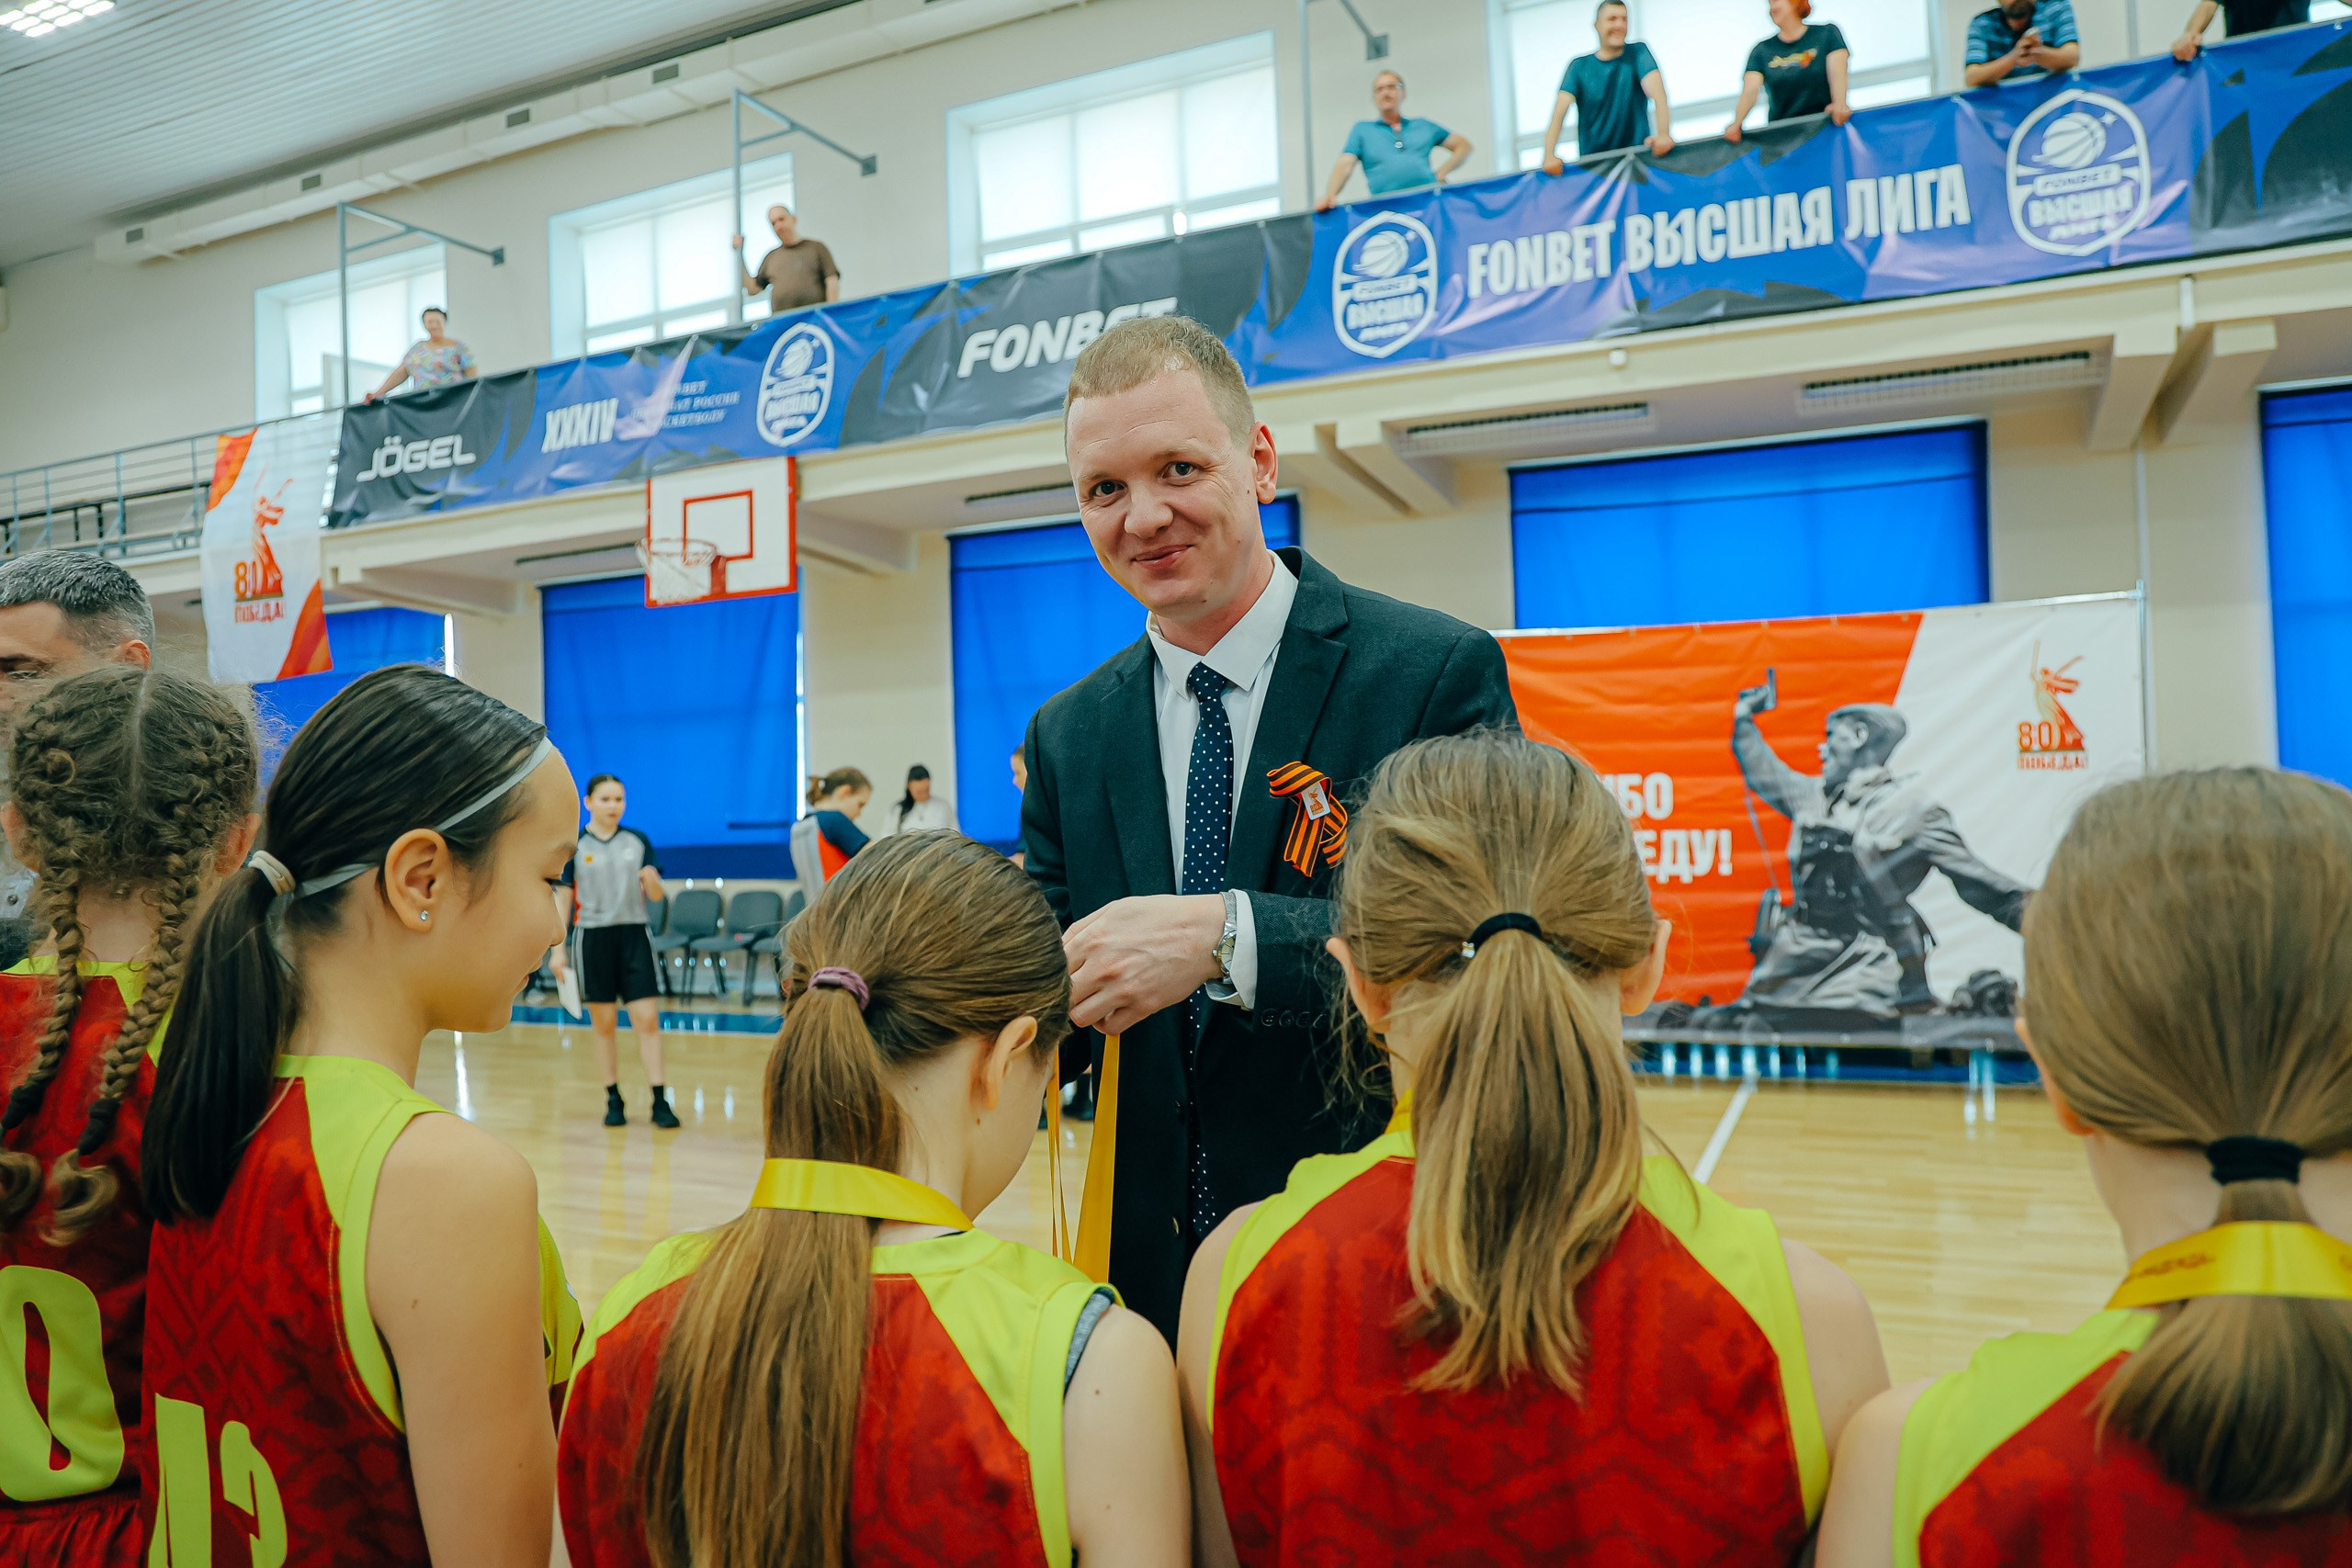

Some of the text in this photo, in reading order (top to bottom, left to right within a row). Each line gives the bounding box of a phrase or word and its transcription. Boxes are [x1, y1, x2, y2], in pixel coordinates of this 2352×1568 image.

[1467, 163, 1972, 299] FONBET ВЫСШАЯ ЛИГА
[956, 297, 1178, 378] FONB
[541, 397, 619, 453] XXXIV
[356, 434, 477, 482] JÖGEL
[2018, 721, 2053, 751] 80
